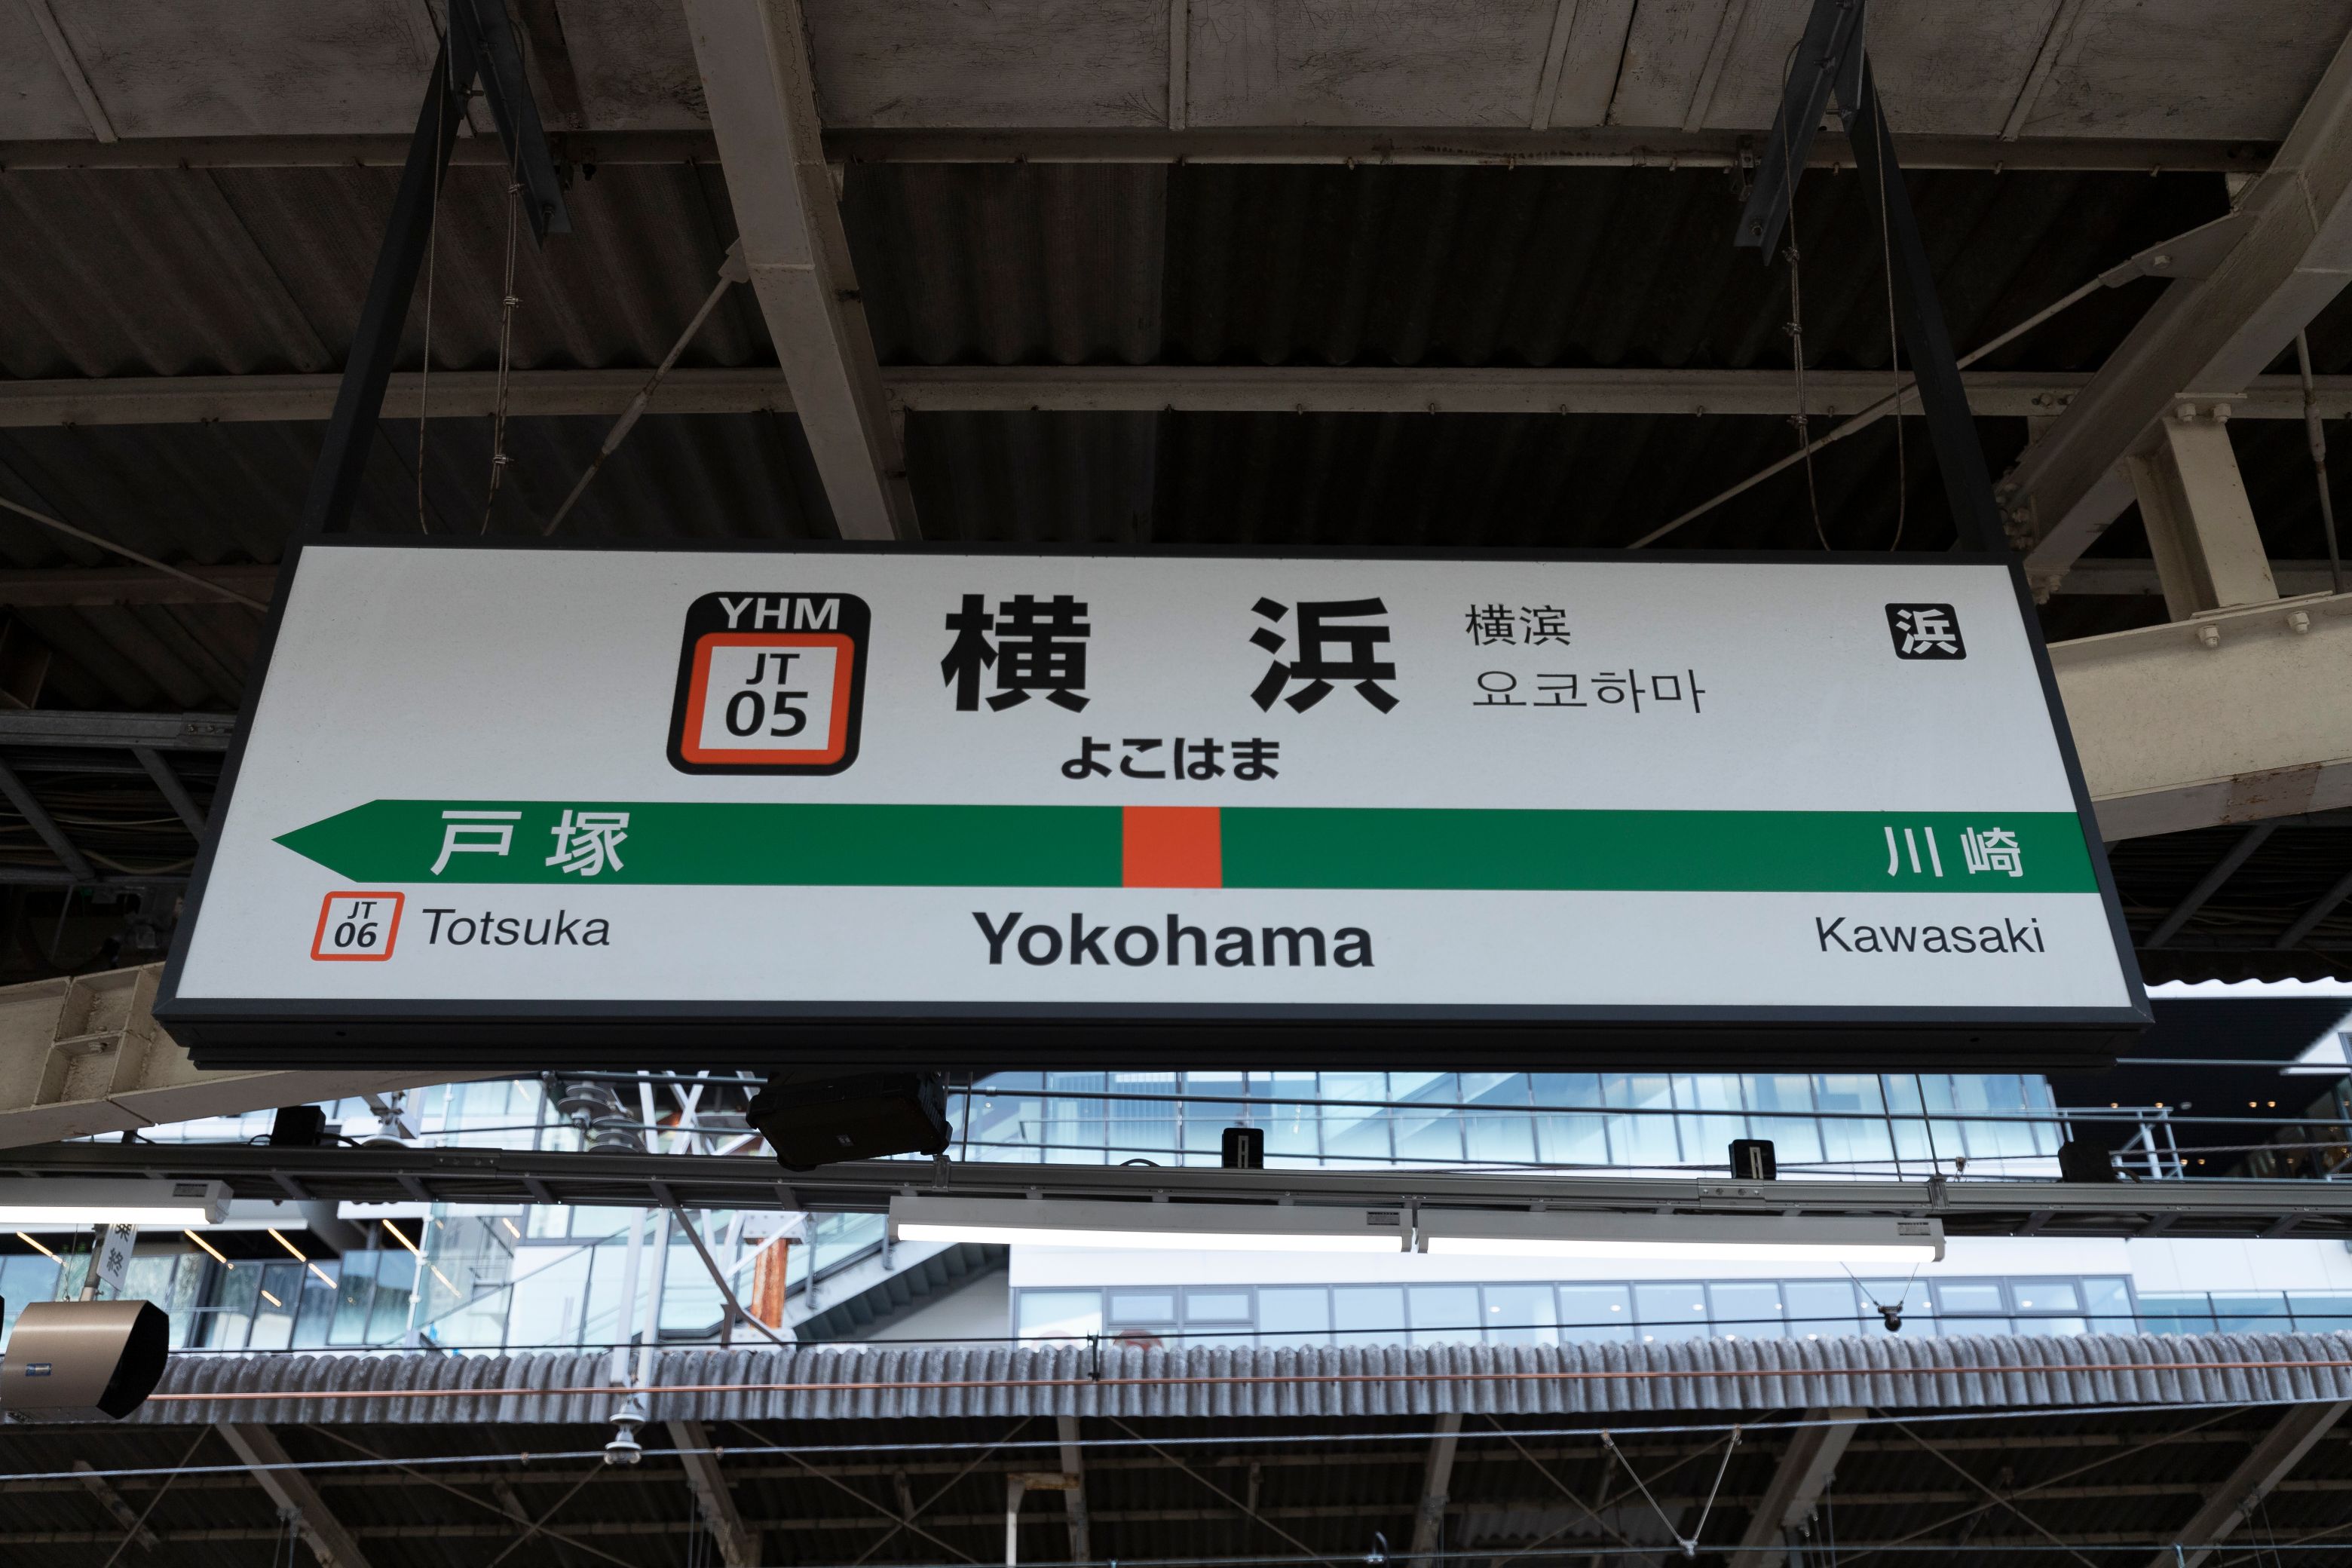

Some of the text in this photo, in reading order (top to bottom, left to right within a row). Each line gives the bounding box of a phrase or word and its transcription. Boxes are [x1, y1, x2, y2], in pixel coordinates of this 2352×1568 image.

[718, 597, 840, 629] YHM
[1465, 603, 1571, 646] 横滨
[1895, 608, 1958, 654] 浜
[746, 653, 801, 685] JT
[940, 593, 1400, 715] 横浜
[725, 690, 809, 737] 05
[1472, 669, 1706, 714] 요코하마
[1061, 736, 1280, 781] よこはま
[430, 810, 630, 876] 戸塚
[1884, 826, 2023, 877] 川崎
[347, 901, 378, 920] JT
[421, 908, 611, 946] Totsuka
[334, 922, 378, 948] 06
[972, 911, 1375, 968] Yokohama
[1815, 916, 2045, 954] Kawasaki
